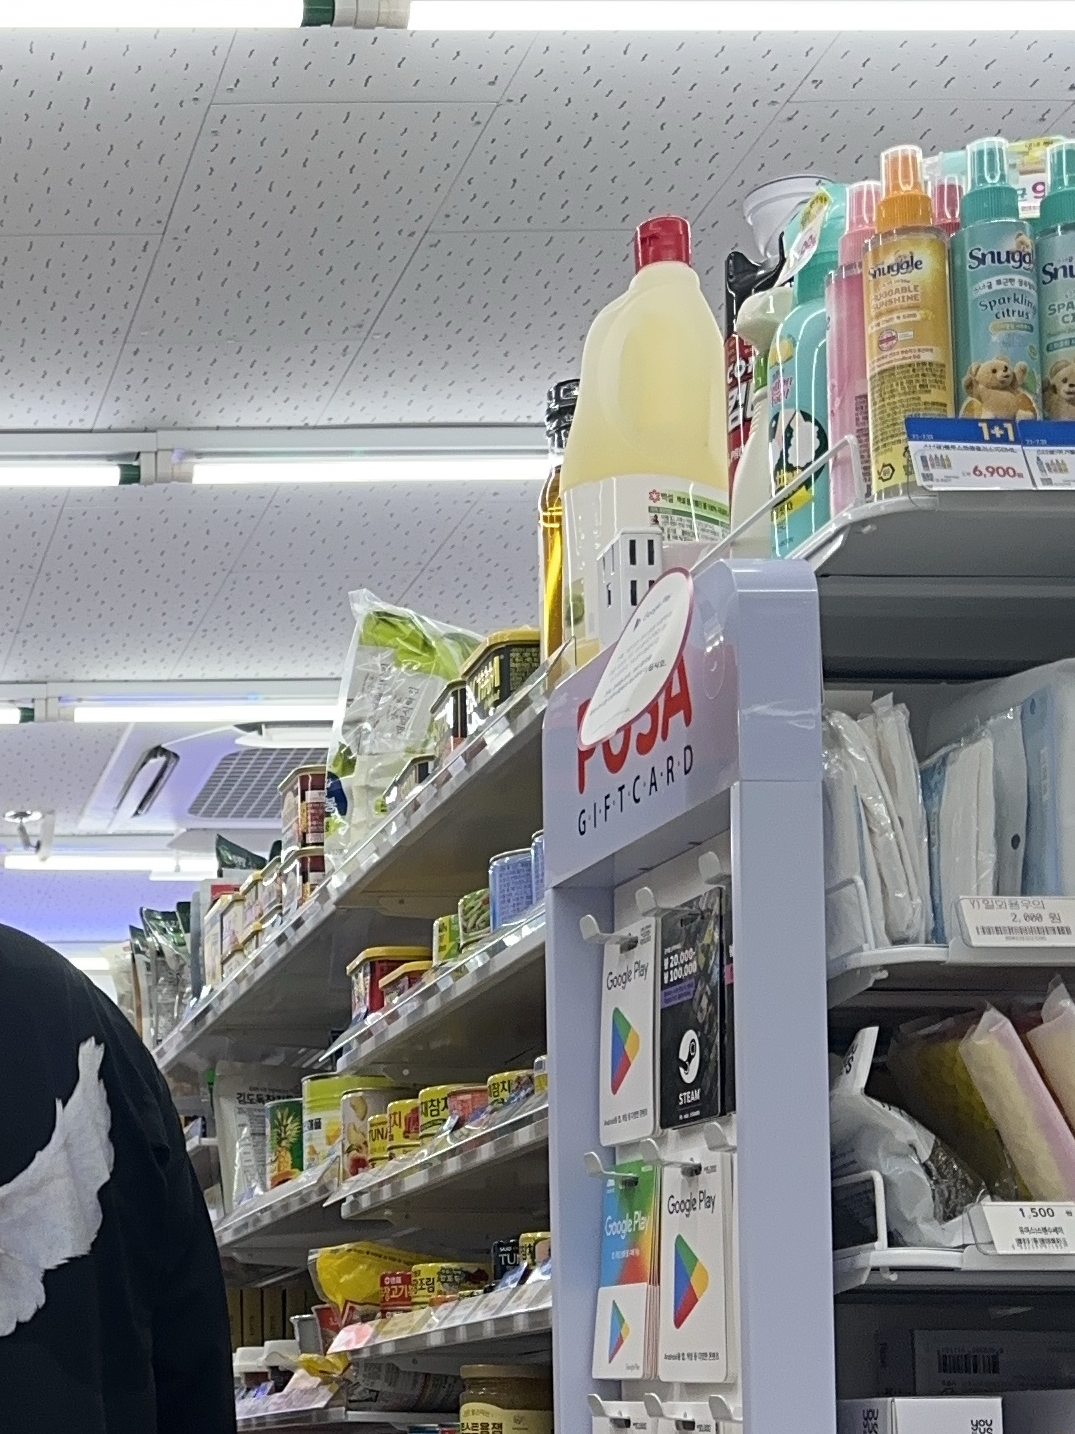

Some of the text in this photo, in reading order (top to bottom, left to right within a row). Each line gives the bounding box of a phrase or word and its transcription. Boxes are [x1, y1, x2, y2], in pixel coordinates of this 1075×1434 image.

[868, 251, 924, 281] Snuggle
[968, 247, 1034, 272] Snugg
[995, 307, 1030, 320] citrus
[1047, 301, 1075, 316] SPA
[978, 422, 1015, 442] 1+1
[972, 464, 1017, 479] 6,900
[1010, 912, 1062, 924] 2,000 원
[606, 960, 649, 991] Google Play
[678, 1089, 701, 1106] STEAM
[667, 1190, 717, 1218] Google Play
[1019, 1207, 1055, 1219] 1,500
[605, 1210, 650, 1239] Google Play
[971, 1419, 993, 1431] you
